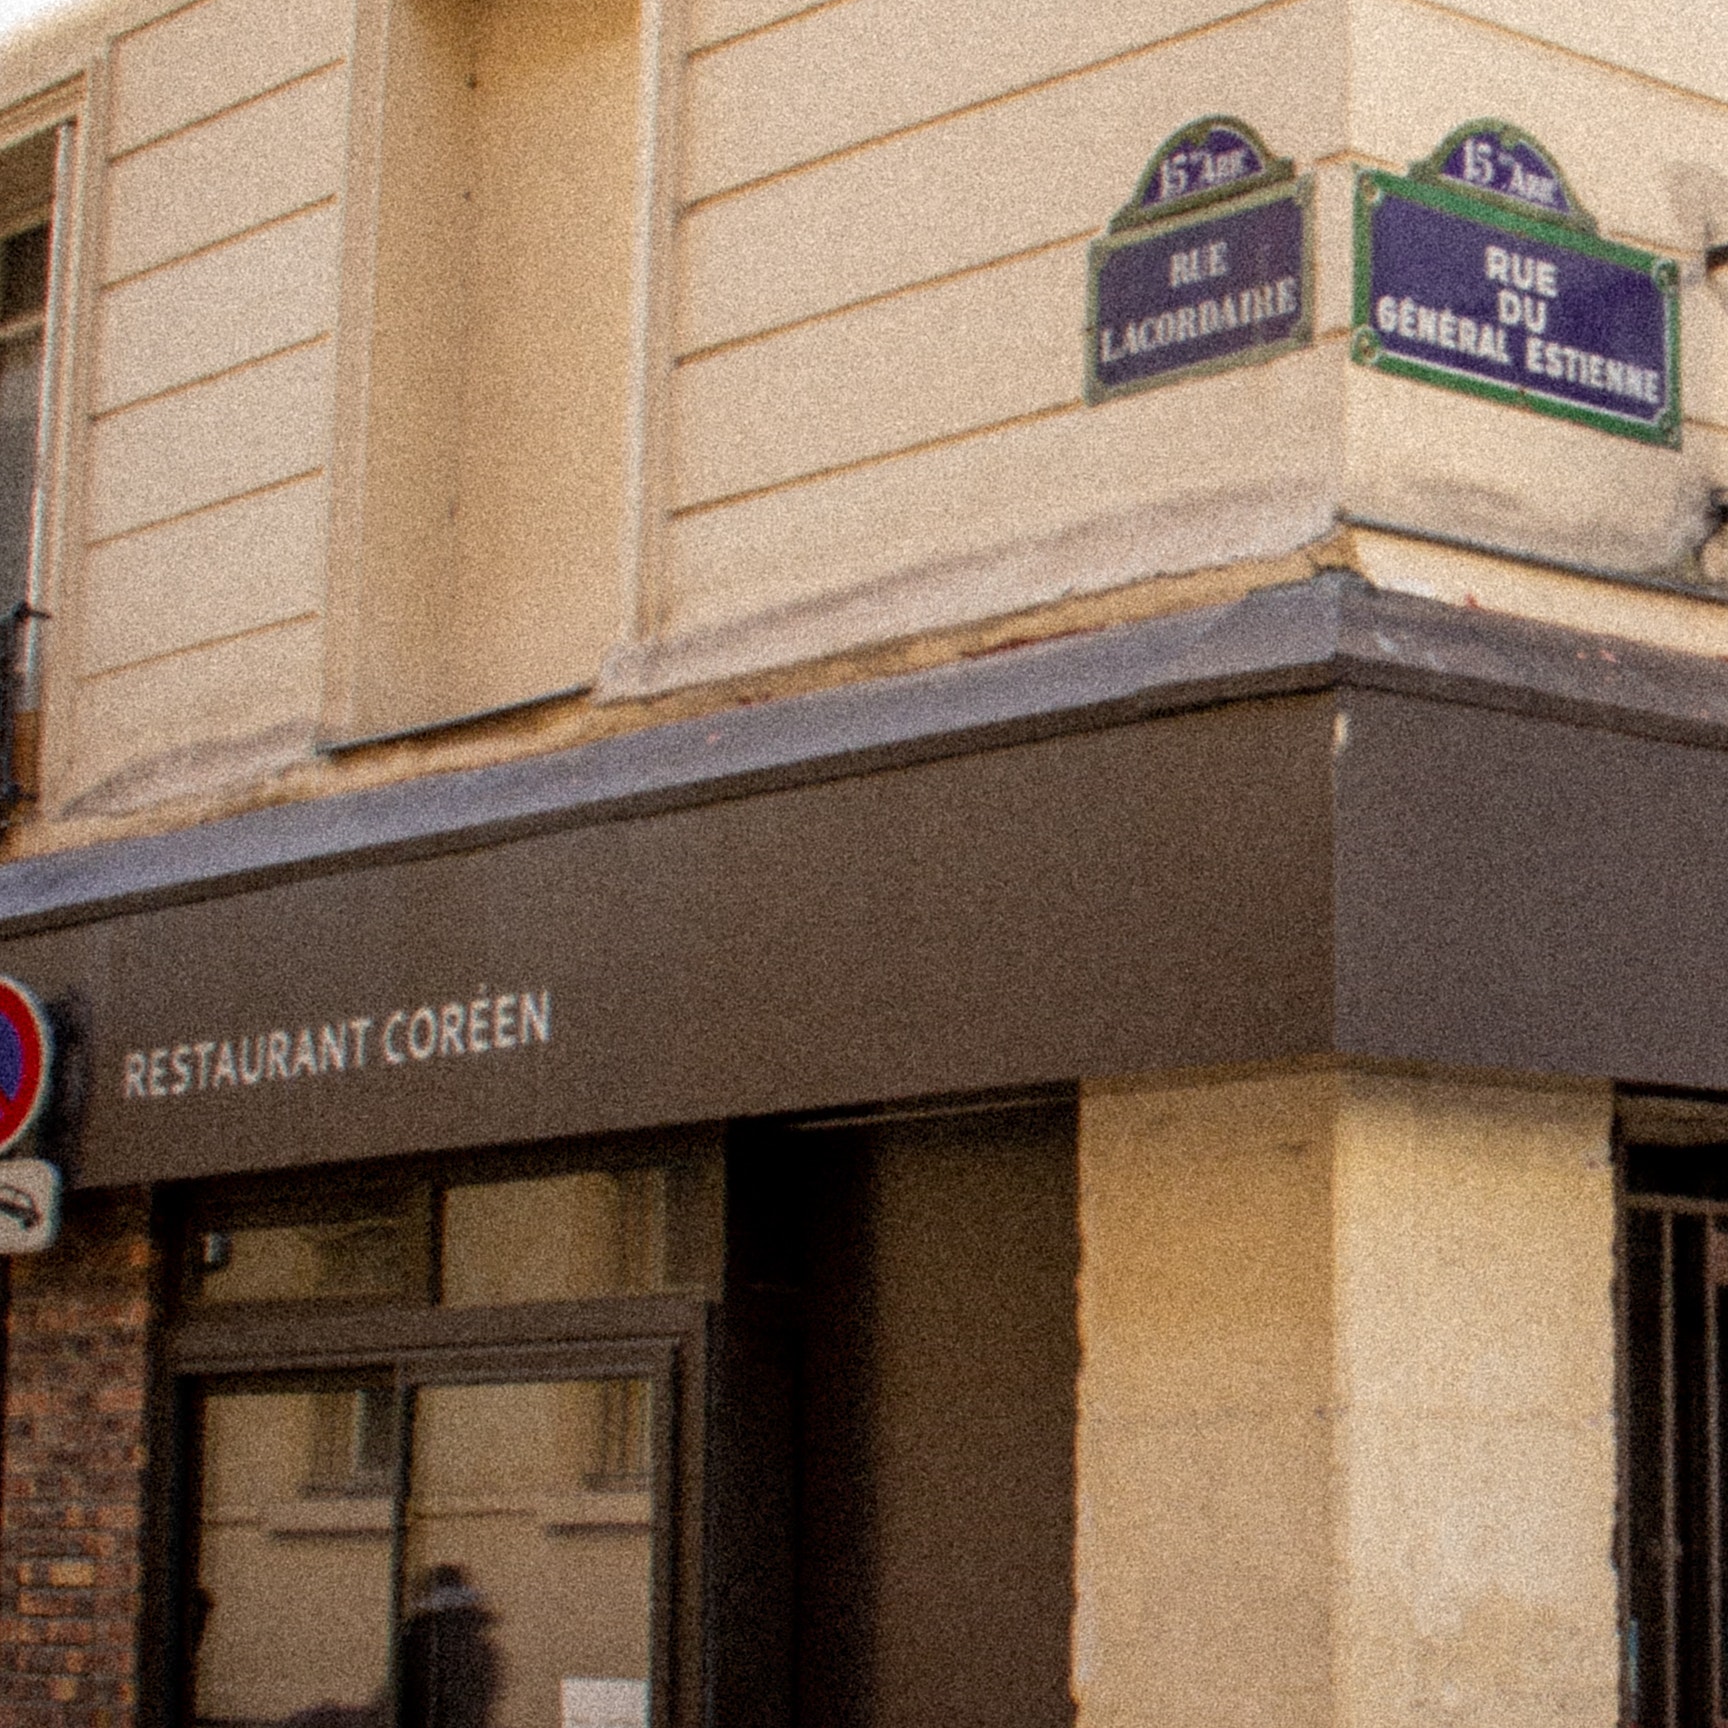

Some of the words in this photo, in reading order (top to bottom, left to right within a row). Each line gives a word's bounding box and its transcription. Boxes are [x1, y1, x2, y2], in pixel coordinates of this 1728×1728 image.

[1168, 239, 1230, 290] RUE
[1484, 244, 1559, 299] RUE
[1100, 274, 1298, 365] LACORDAIRE
[1498, 287, 1548, 336] DU
[1376, 294, 1511, 365] GÉNÉRAL
[1525, 336, 1661, 405] ESTIENNE
[123, 1016, 374, 1099] RESTAURANT
[380, 983, 553, 1065] CORÉEN
